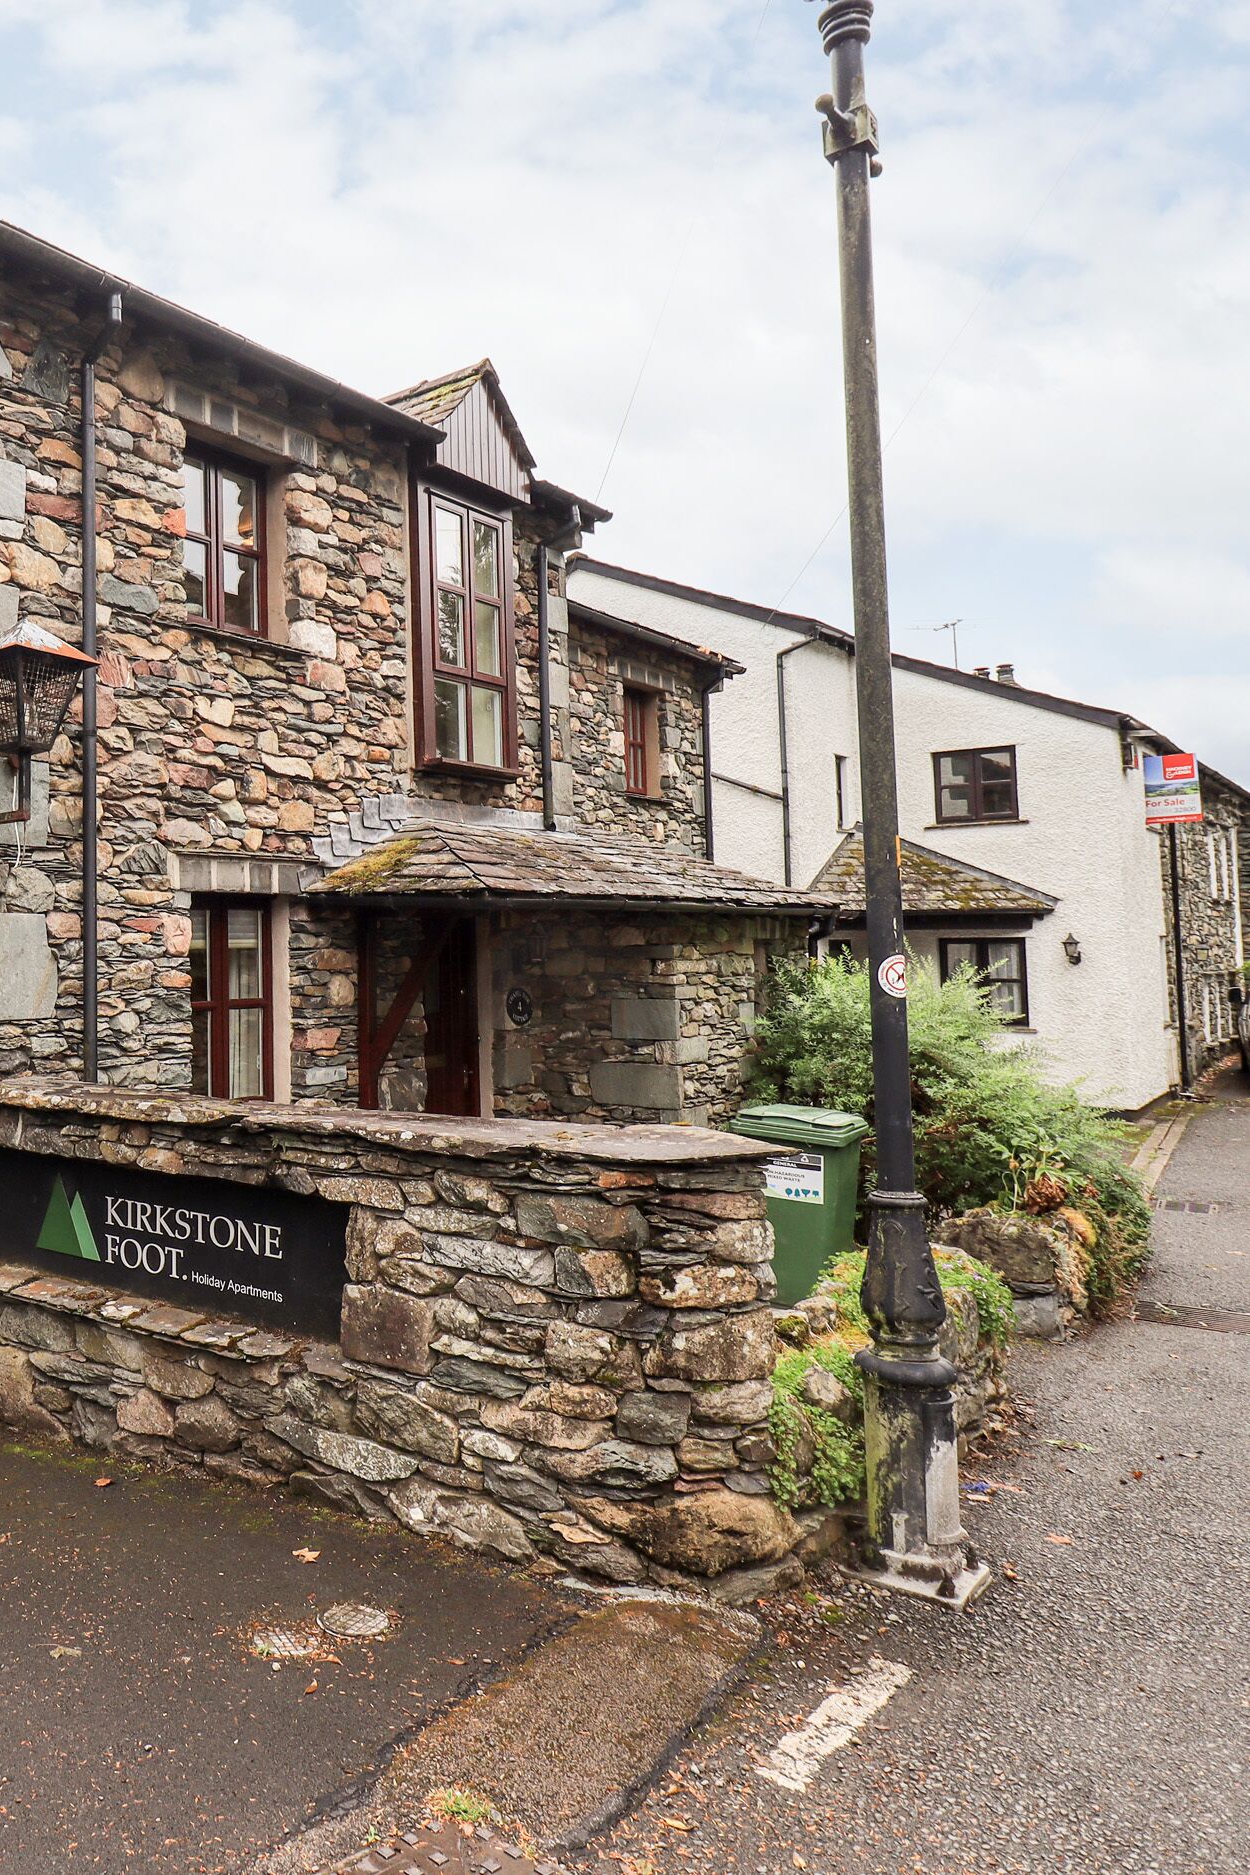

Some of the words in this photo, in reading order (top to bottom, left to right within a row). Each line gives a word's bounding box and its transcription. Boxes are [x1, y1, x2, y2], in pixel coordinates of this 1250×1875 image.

[1145, 800, 1162, 808] For
[1164, 798, 1185, 807] Sale
[104, 1195, 283, 1260] KIRKSTONE
[104, 1233, 188, 1281] FOOT.
[191, 1270, 226, 1293] Holiday
[227, 1279, 283, 1303] Apartments
